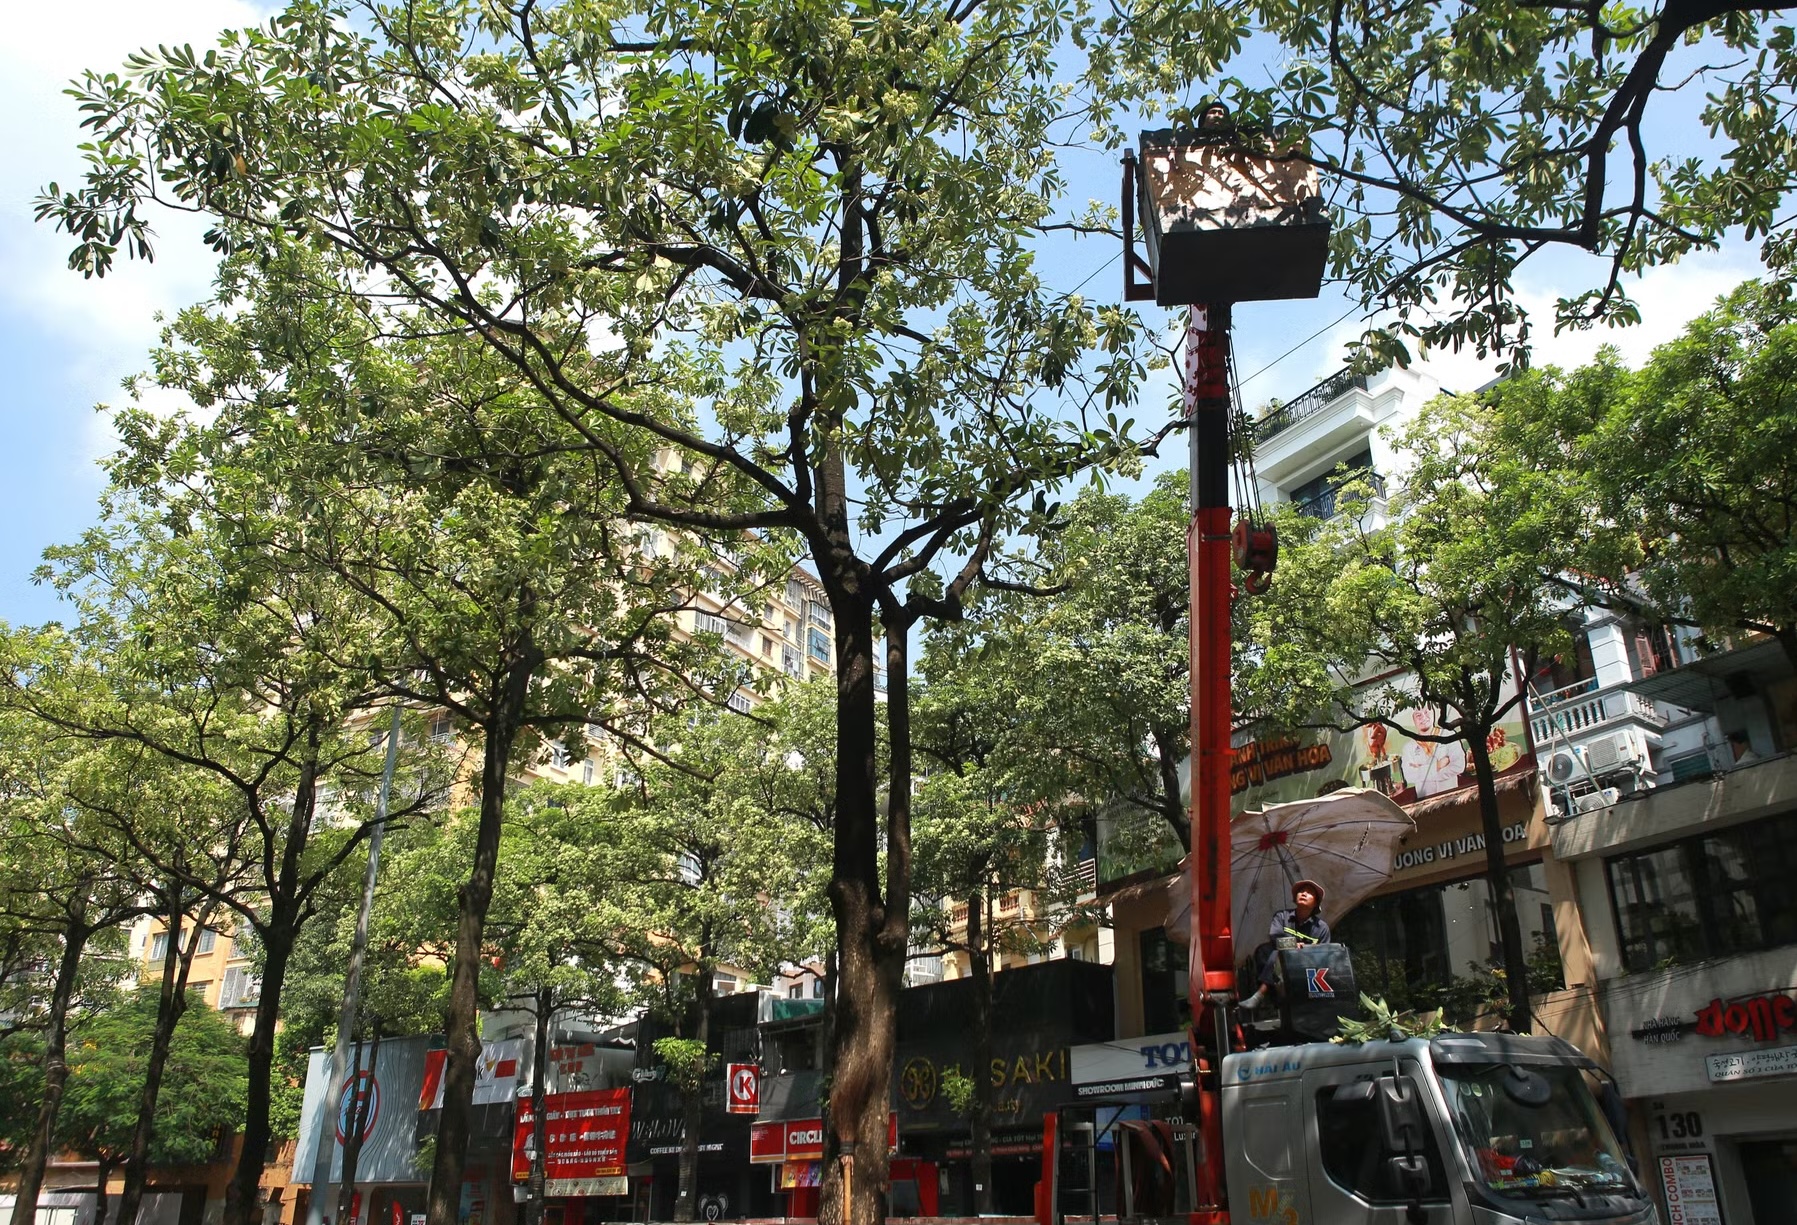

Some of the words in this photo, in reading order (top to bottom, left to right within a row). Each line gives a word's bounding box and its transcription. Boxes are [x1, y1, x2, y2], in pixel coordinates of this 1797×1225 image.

[1141, 1041, 1191, 1068] TOT
[1078, 1082, 1124, 1096] SHOWROOM
[1657, 1111, 1703, 1140] 130
[1662, 1158, 1679, 1202] COMBO
